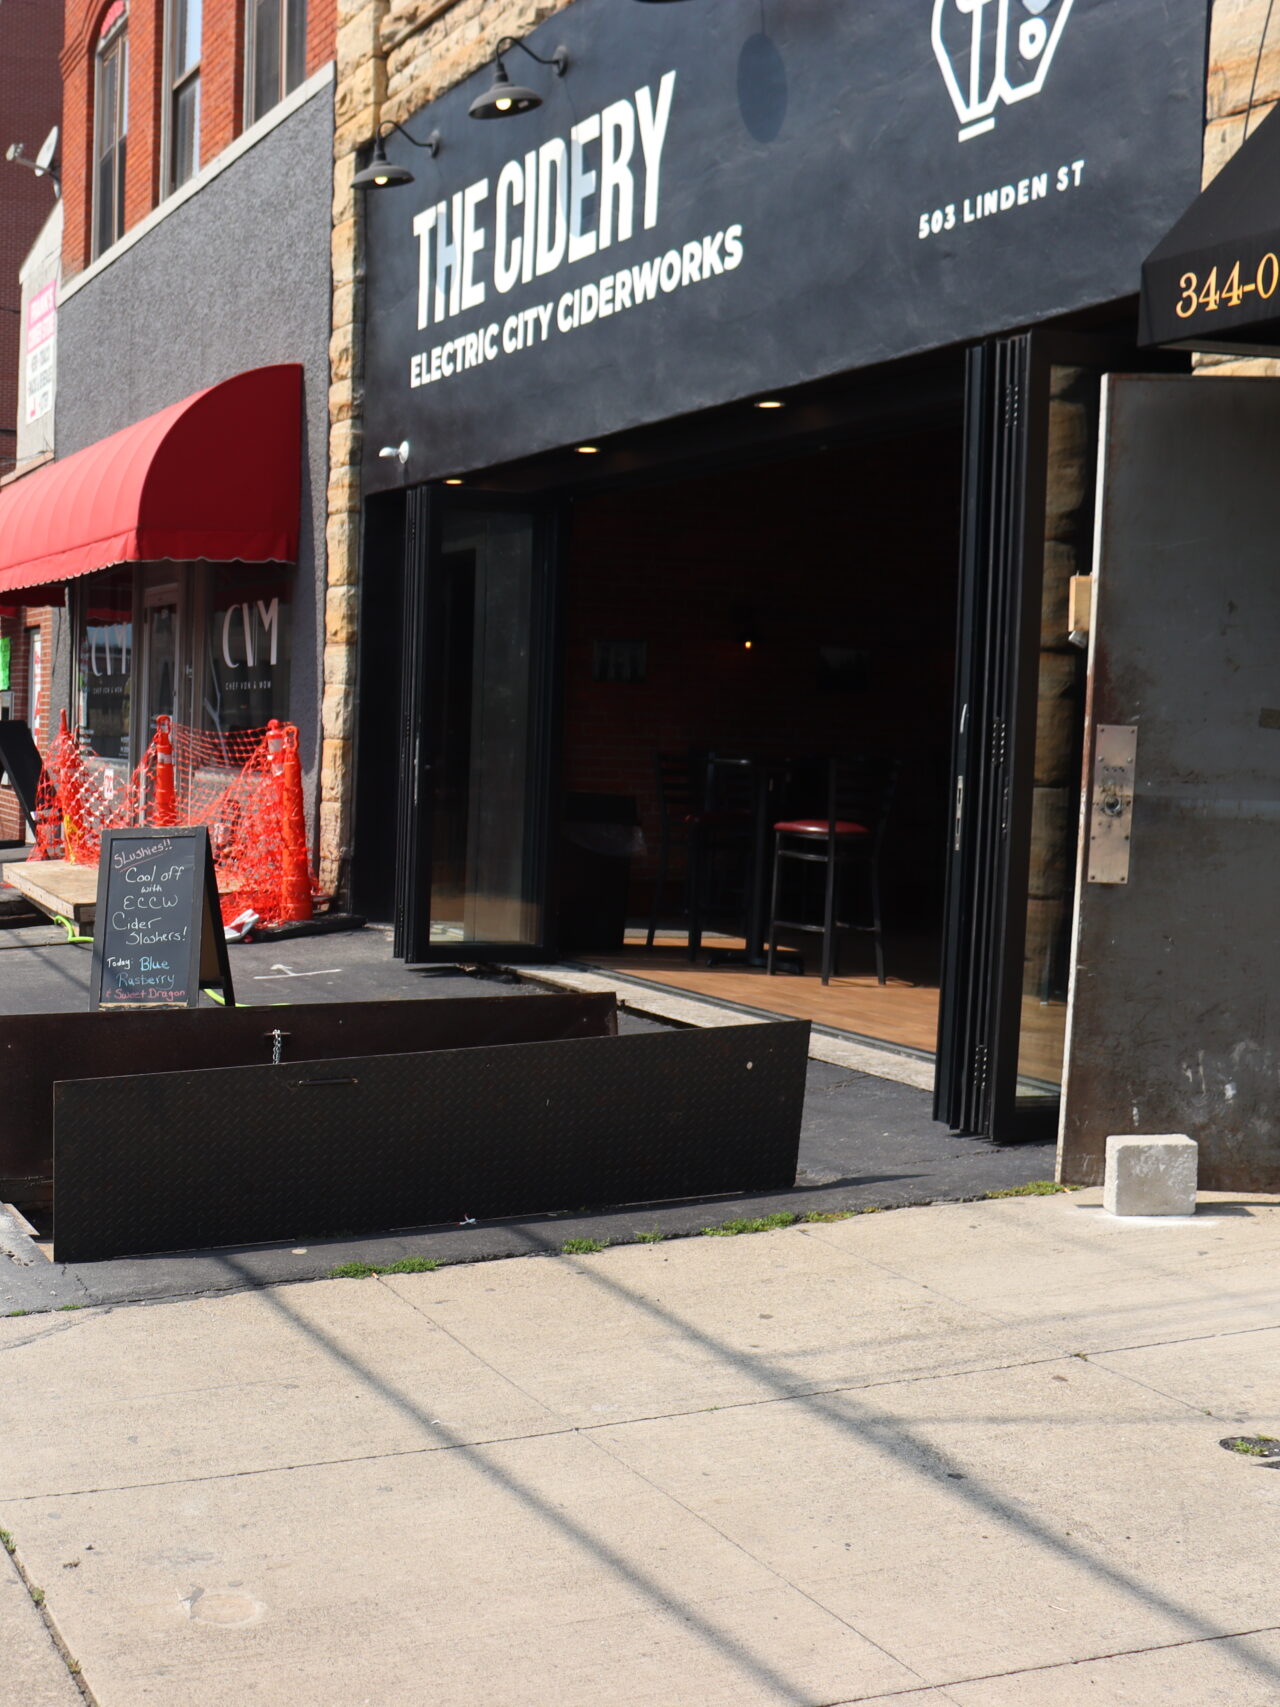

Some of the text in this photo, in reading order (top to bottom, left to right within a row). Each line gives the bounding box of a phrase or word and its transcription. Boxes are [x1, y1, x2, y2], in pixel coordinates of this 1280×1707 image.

[413, 70, 676, 331] THE CIDERY
[918, 159, 1085, 239] 503 LINDEN ST
[1175, 252, 1280, 319] 344-0
[410, 224, 744, 389] ELECTRIC CITY CIDERWORKS
[125, 865, 184, 883] Cool off
[141, 884, 163, 894] with
[123, 895, 179, 910] ECCW
[112, 911, 162, 930] Cider
[139, 956, 170, 971] Blue
[148, 987, 186, 1002] Dragon
